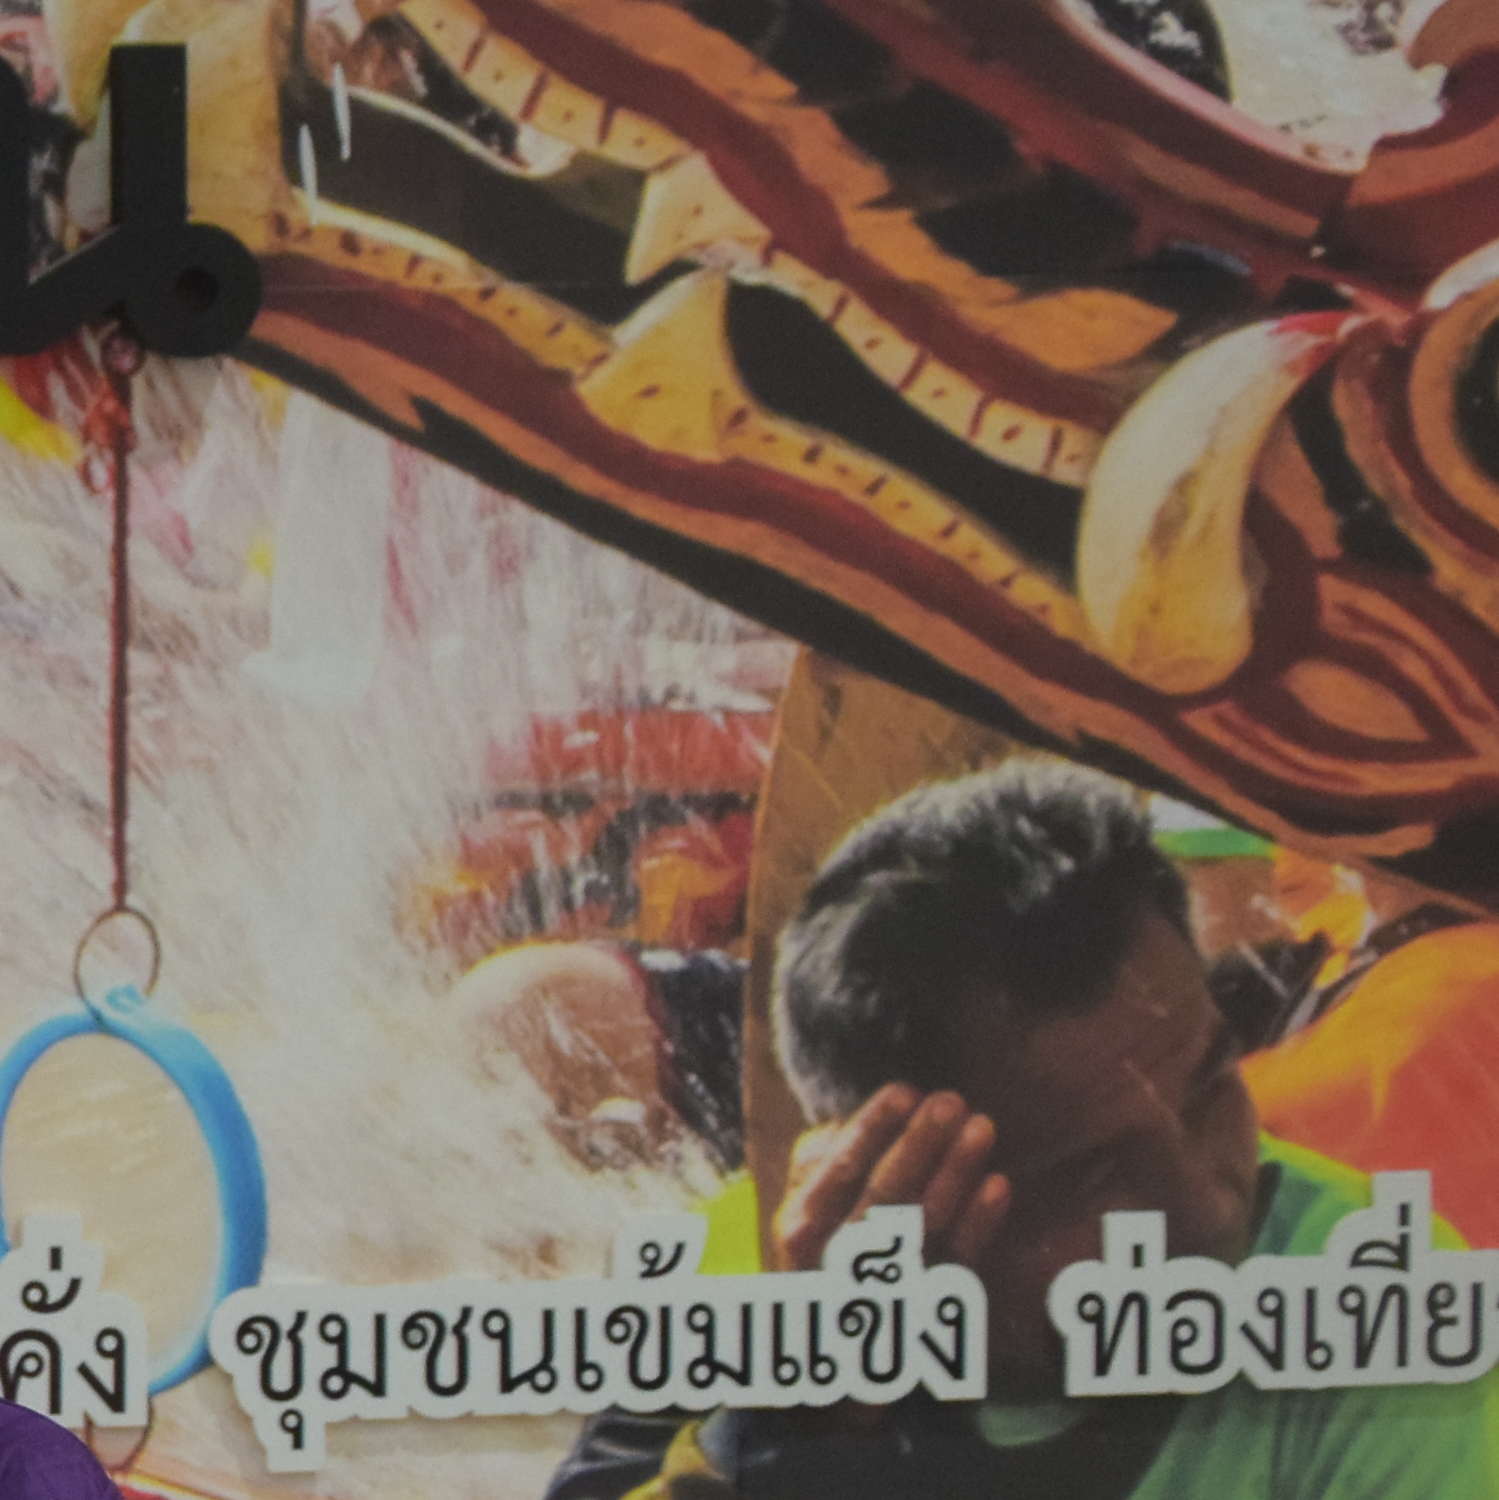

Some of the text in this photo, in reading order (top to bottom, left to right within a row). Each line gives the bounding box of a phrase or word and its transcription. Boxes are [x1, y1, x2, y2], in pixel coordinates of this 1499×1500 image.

[235, 1235, 968, 1450] ชุมชนเข้มแข็ง
[1077, 1203, 1499, 1377] ท่องเที่ย
